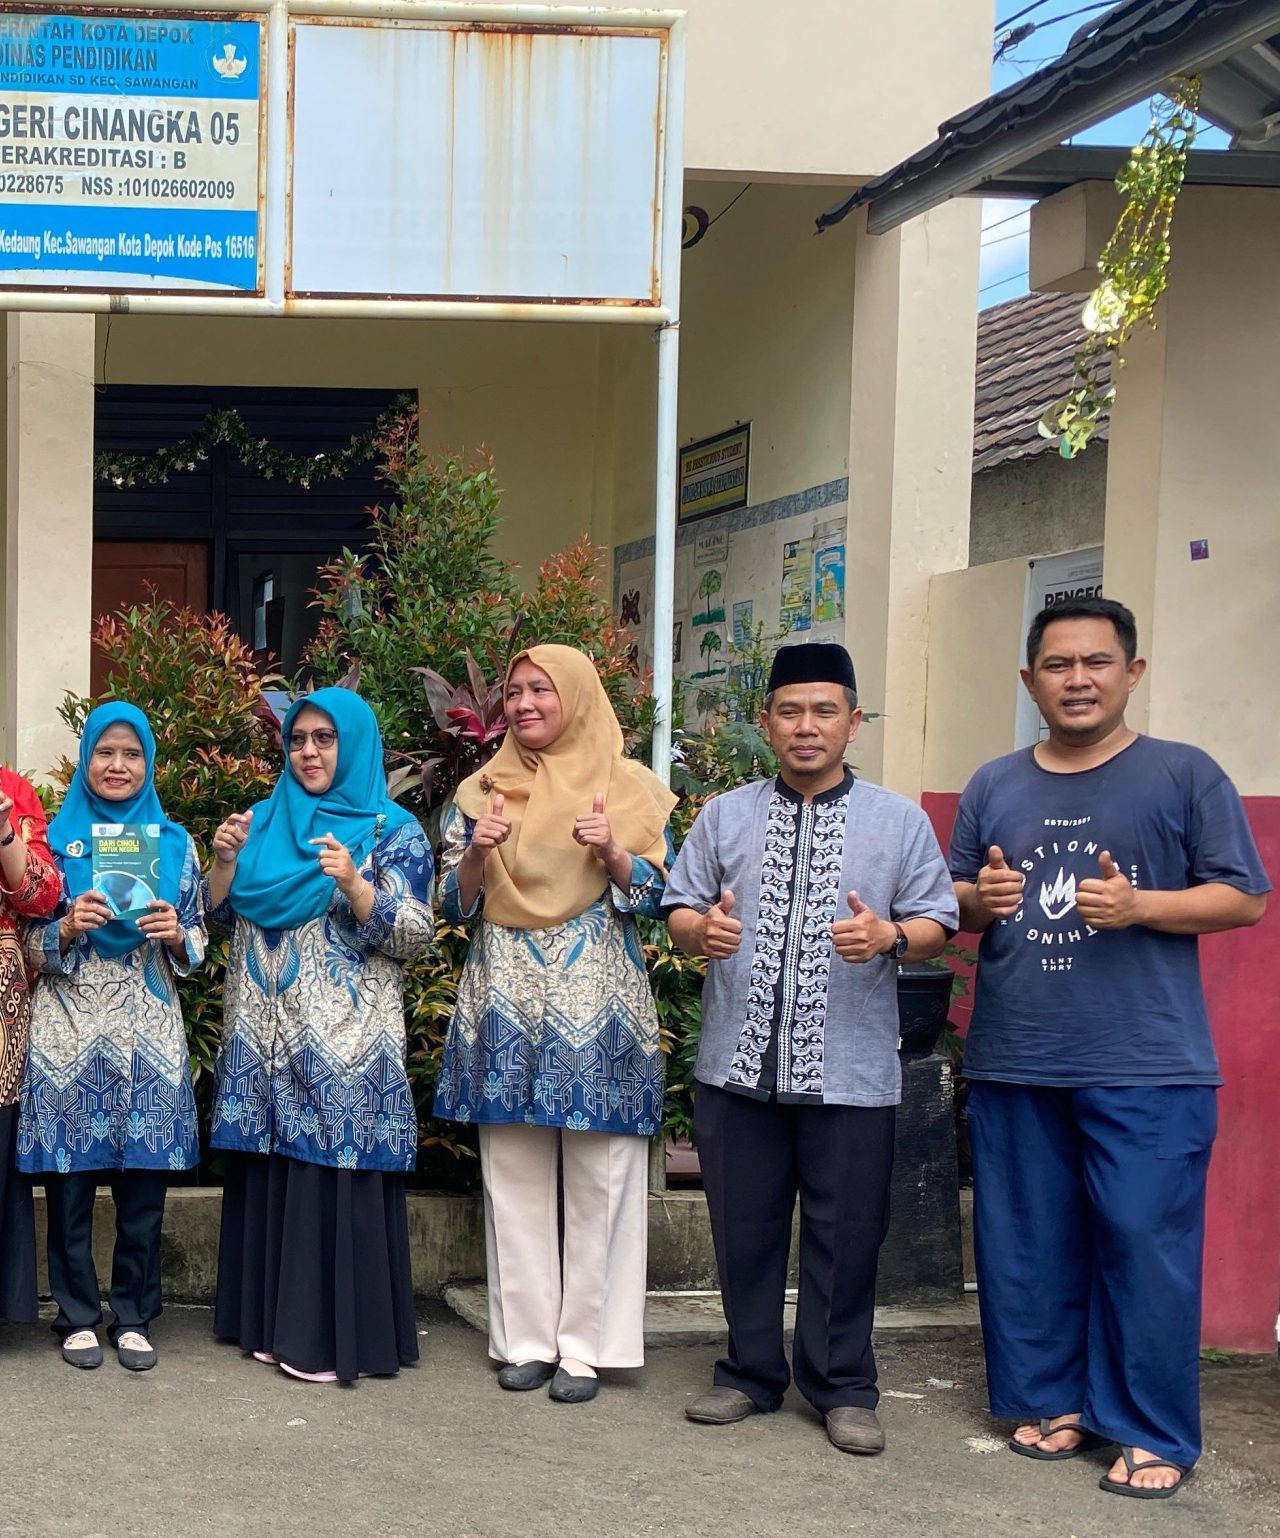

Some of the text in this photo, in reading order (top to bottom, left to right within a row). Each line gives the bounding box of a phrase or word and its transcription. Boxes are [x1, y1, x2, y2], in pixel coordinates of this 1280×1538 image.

[81, 23, 128, 42] KOTA
[134, 25, 195, 45] DEPOK
[51, 44, 158, 72] PENDIDIKAN
[70, 74, 85, 86] SD
[90, 76, 120, 88] KEC.
[124, 77, 199, 90] SAWANGAN
[64, 106, 202, 145] CINANGKA
[210, 111, 240, 146] 05
[173, 151, 187, 170] B
[81, 176, 113, 196] NSS
[119, 232, 141, 256] Kota
[144, 233, 175, 263] Depok
[177, 234, 202, 258] Kode
[205, 235, 222, 258] Pos
[225, 235, 254, 259] 16516
